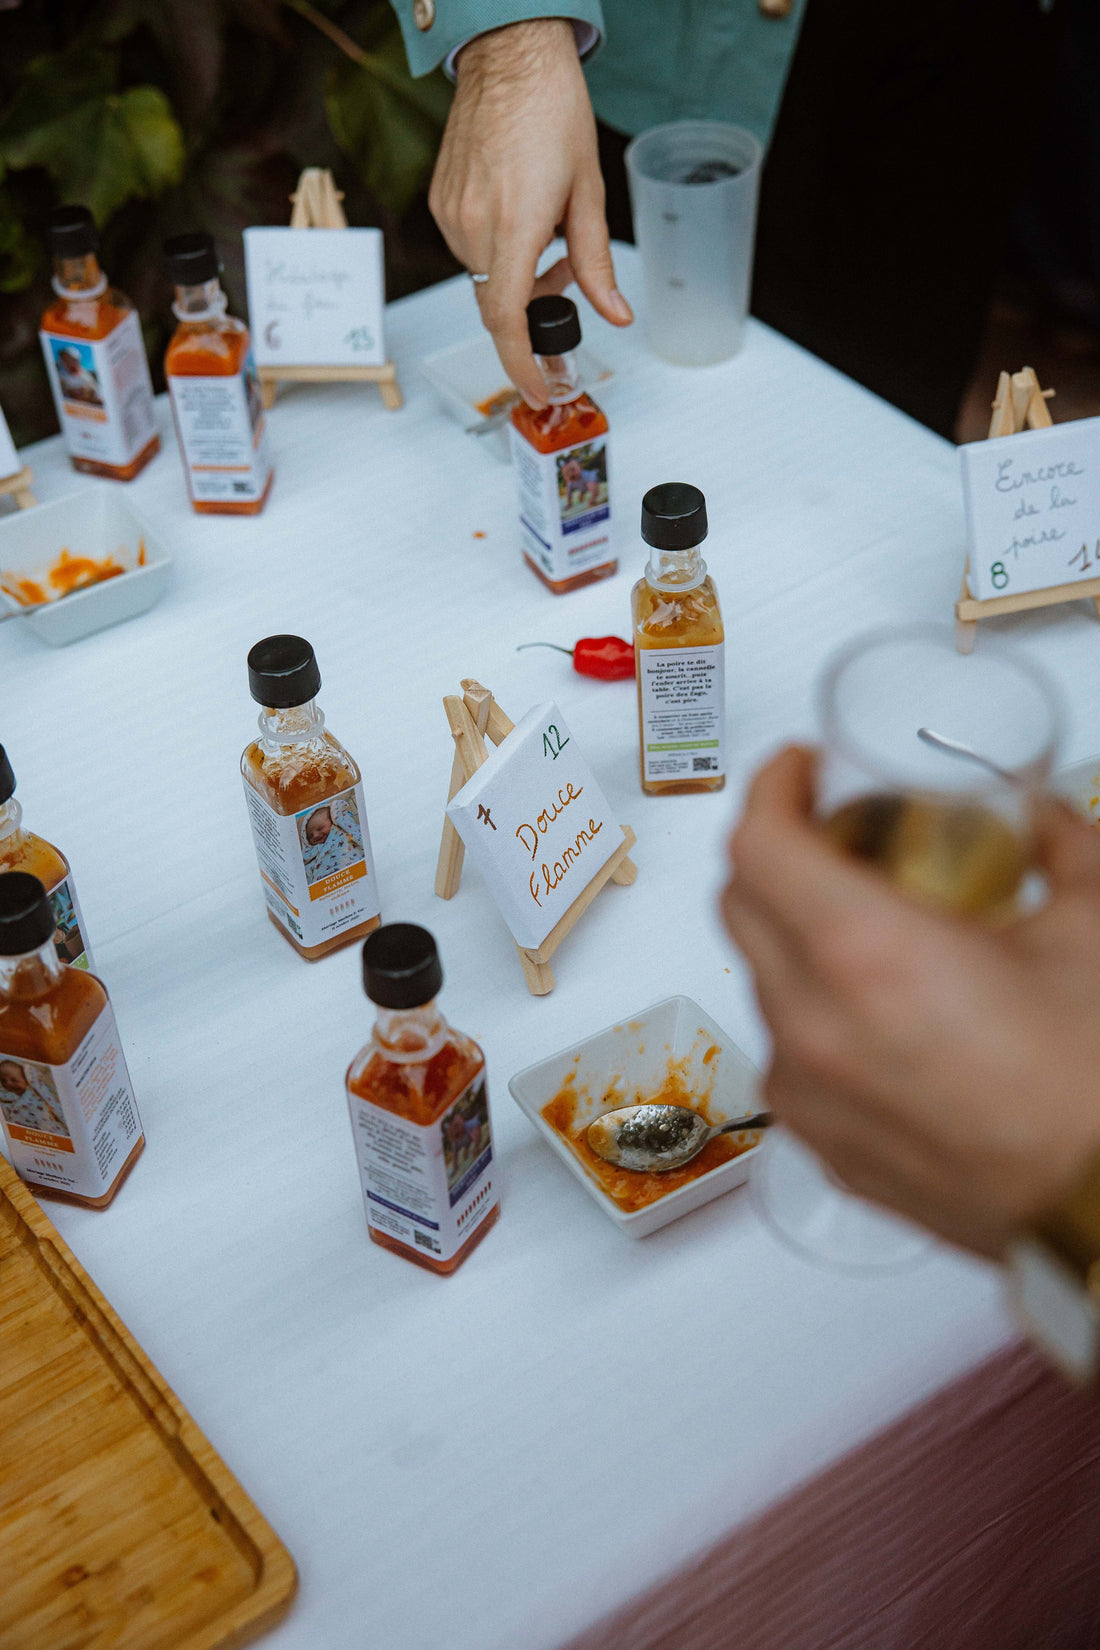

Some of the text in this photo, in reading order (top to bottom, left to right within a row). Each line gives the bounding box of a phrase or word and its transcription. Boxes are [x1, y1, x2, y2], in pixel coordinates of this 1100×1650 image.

[994, 458, 1085, 493] Encore
[1012, 485, 1078, 521] de la
[1002, 526, 1068, 561] poire
[990, 560, 1009, 590] 8
[667, 660, 685, 668] poire
[656, 692, 674, 700] poire
[541, 723, 570, 760] 12
[515, 781, 584, 862] Douce
[325, 869, 351, 885] DOUCE
[528, 818, 603, 908] Flamme
[323, 875, 355, 892] FLAMME
[25, 1130, 54, 1140] DOUCE
